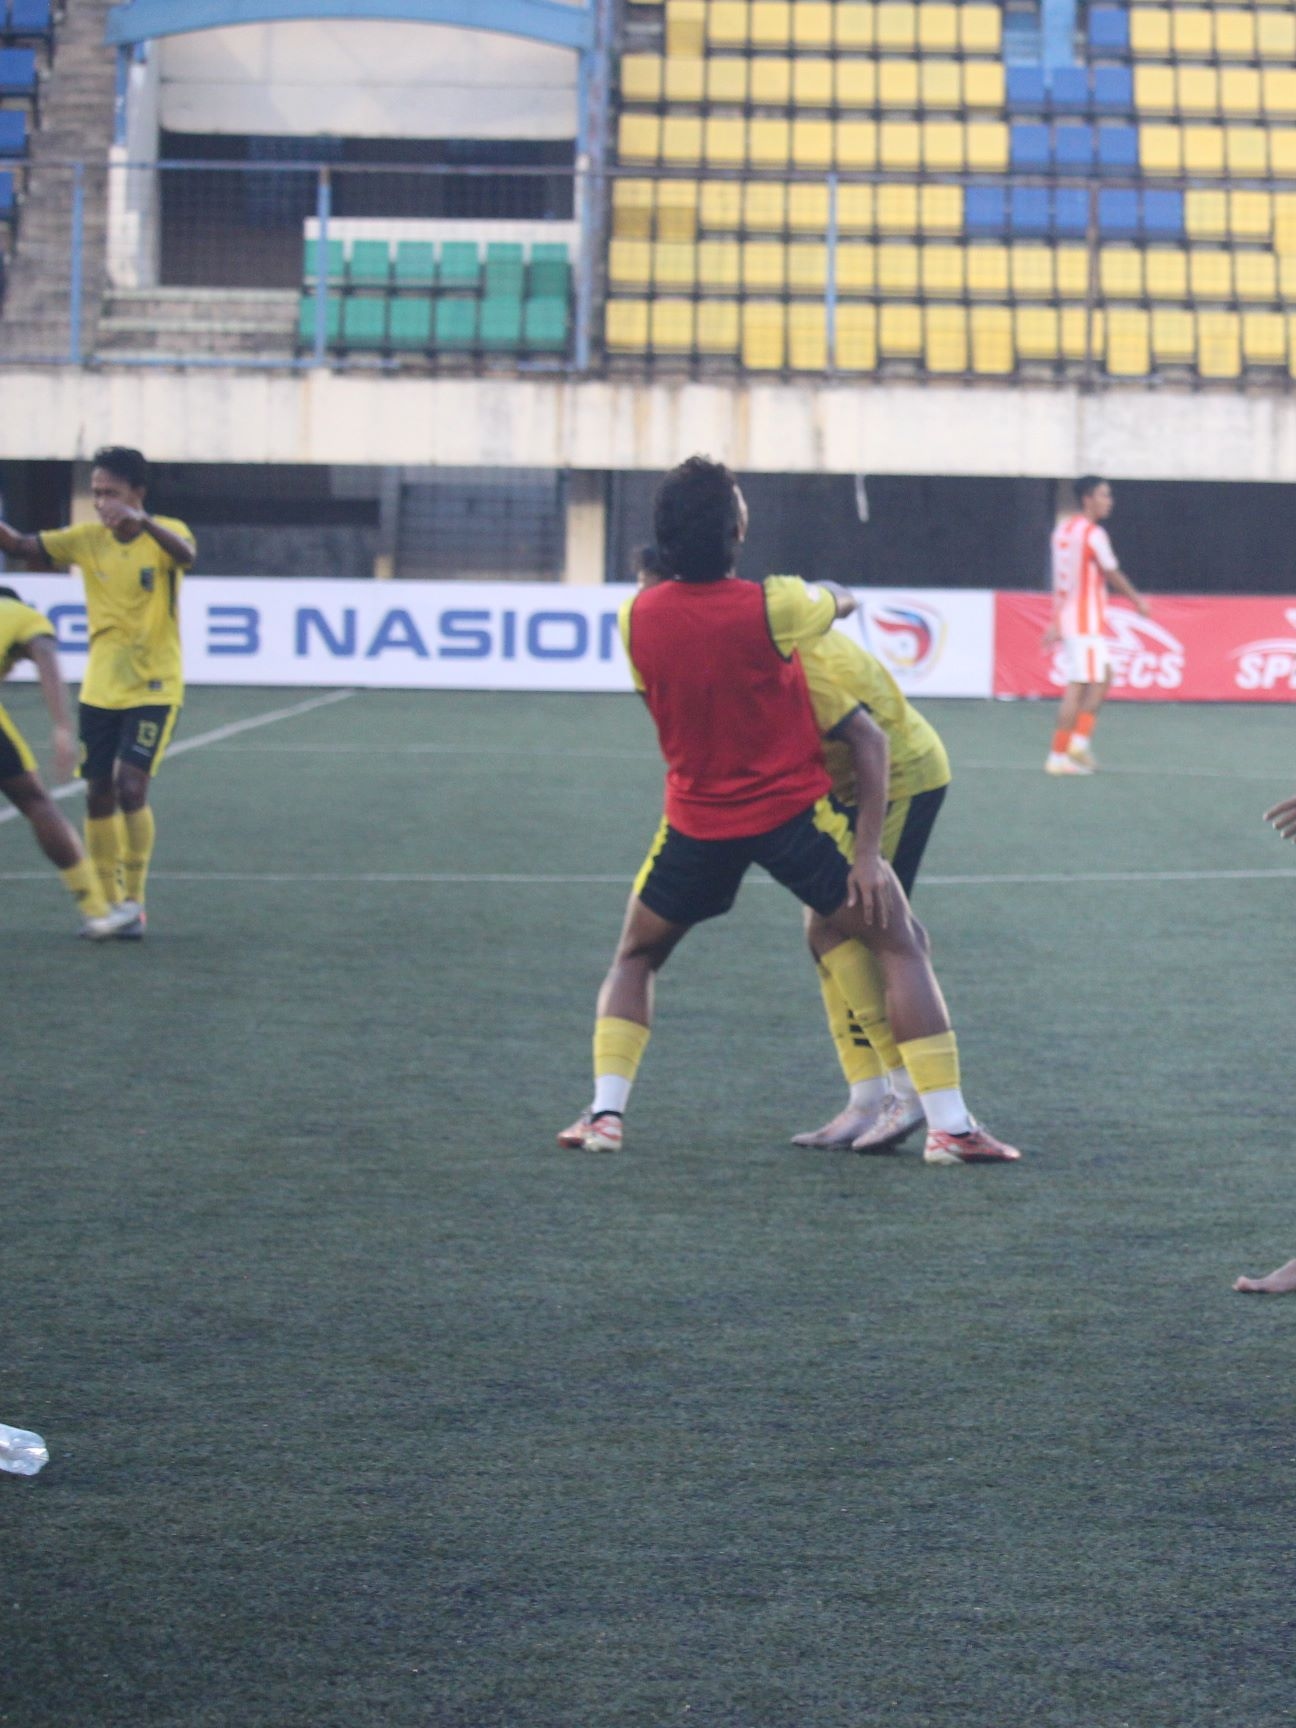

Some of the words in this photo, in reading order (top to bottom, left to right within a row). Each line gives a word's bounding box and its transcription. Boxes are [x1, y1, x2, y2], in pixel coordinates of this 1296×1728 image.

[206, 606, 261, 655] 3
[294, 606, 619, 660] NASIO
[1048, 650, 1185, 689] SECS
